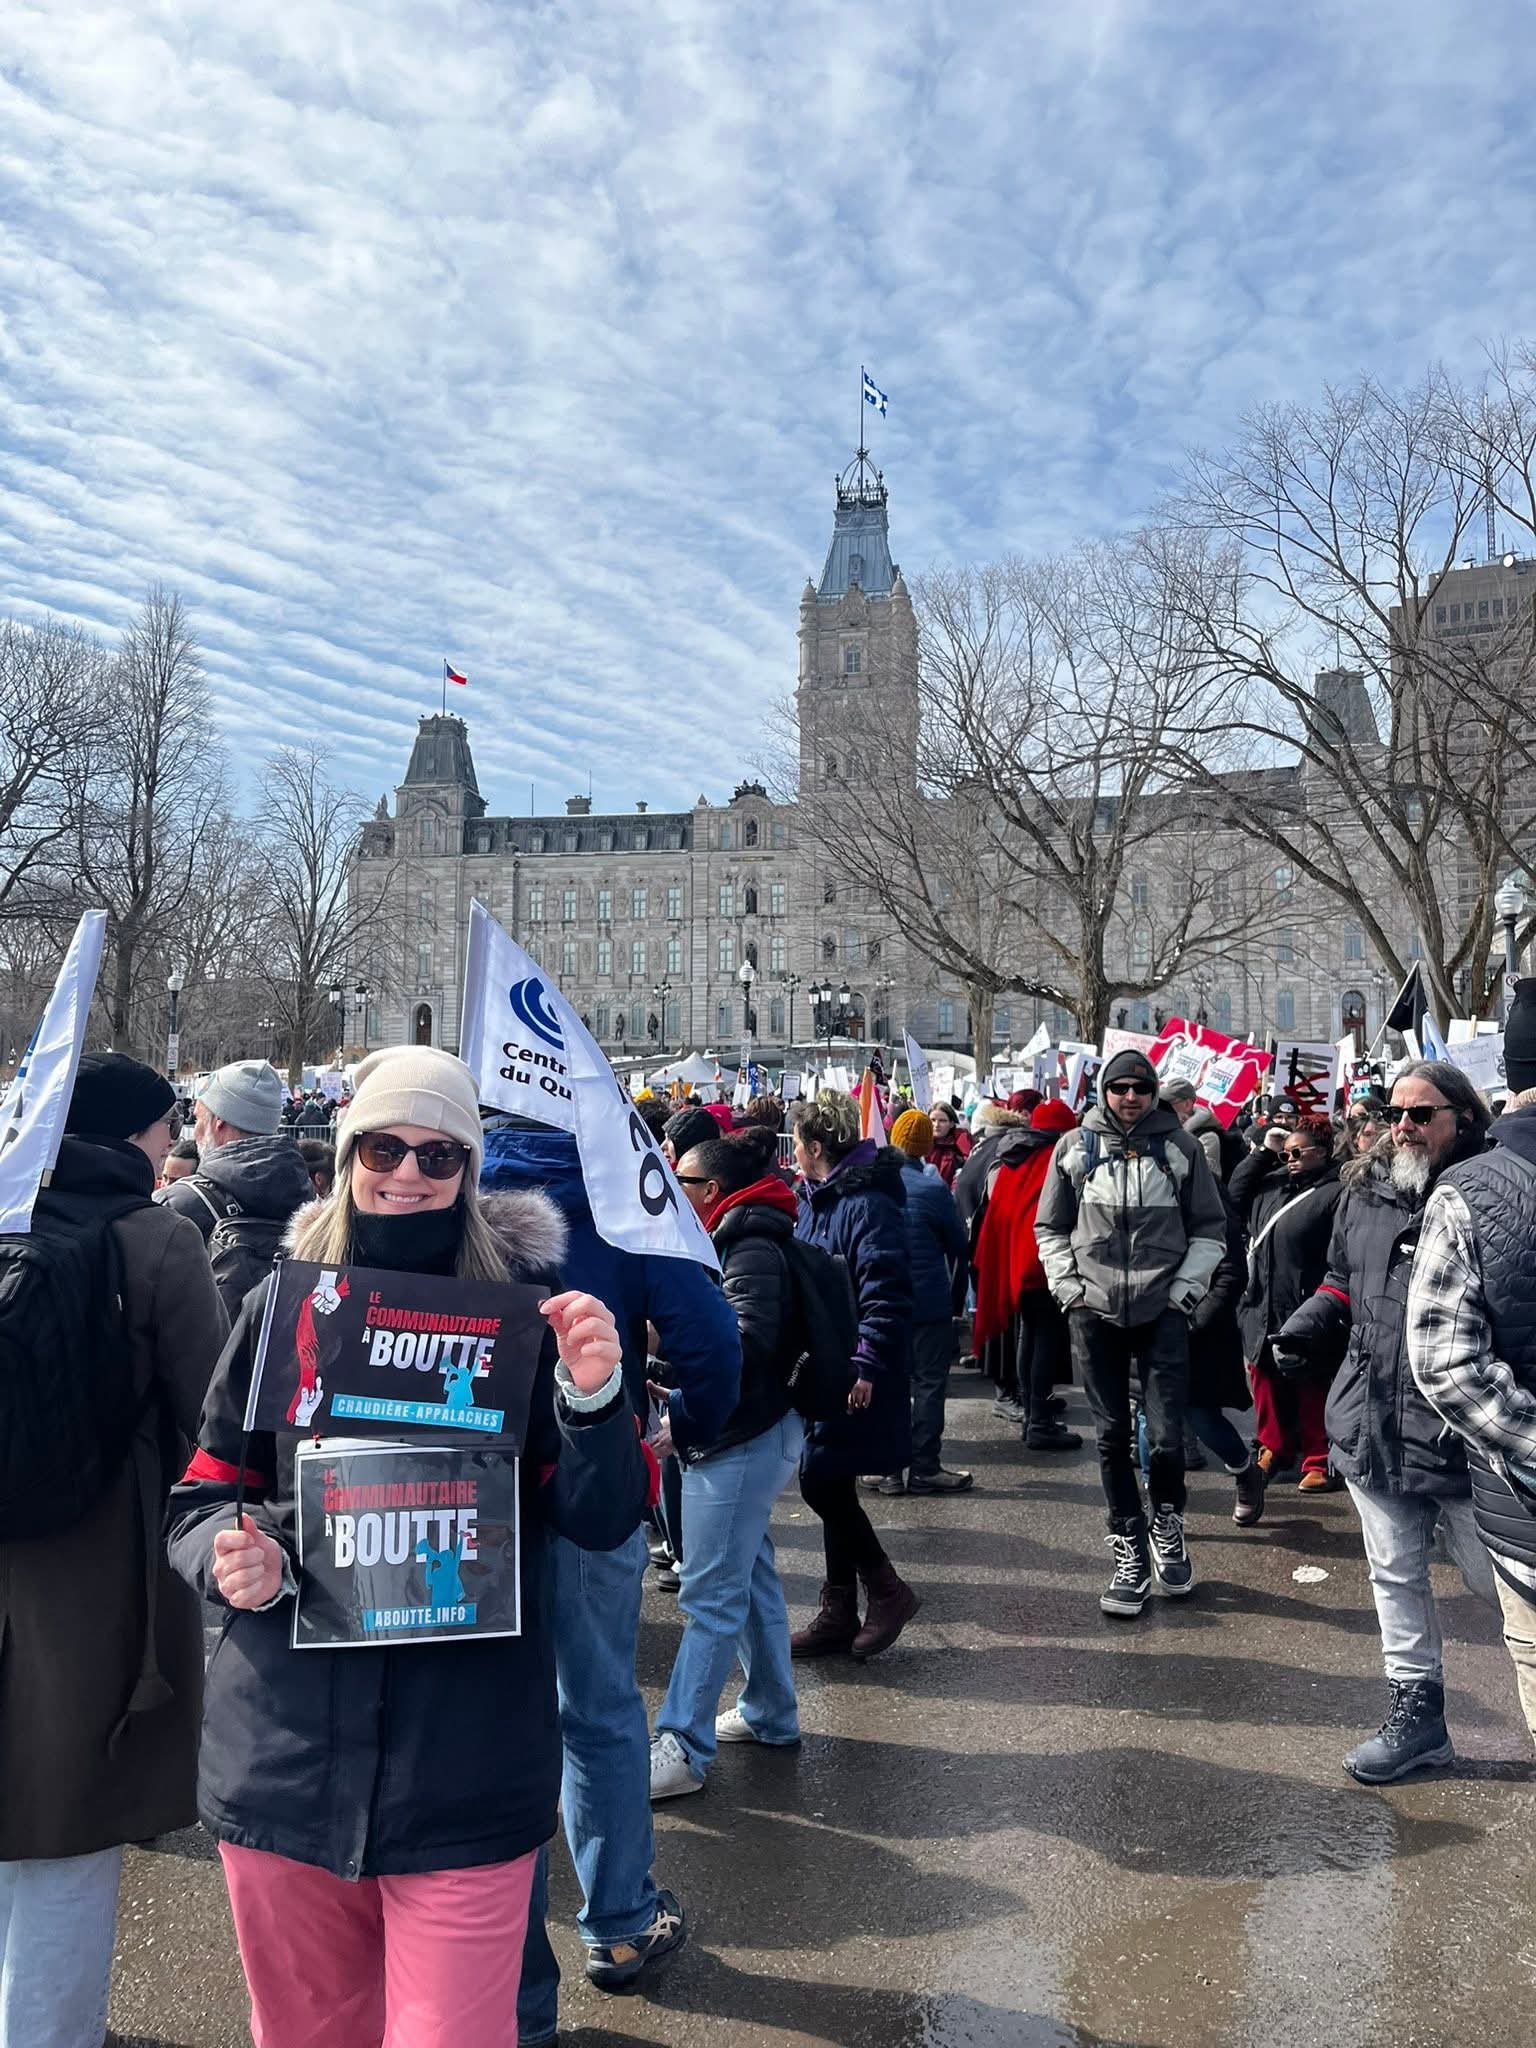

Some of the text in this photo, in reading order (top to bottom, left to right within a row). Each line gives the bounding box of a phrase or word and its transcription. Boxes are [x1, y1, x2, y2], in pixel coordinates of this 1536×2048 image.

[499, 1065, 572, 1101] du Qu
[369, 1291, 382, 1304] LE
[366, 1306, 501, 1335] COMMUNAUTAIRE
[361, 1326, 496, 1378] À BOUTTE
[337, 1398, 499, 1428] CHAUDIÈRE-APPALACHES
[324, 1469, 337, 1484] LE
[323, 1481, 477, 1511] COMMUNAUTAIRE
[325, 1509, 478, 1568] À BOUTTE
[375, 1606, 466, 1627] ABOUTTE.INFO
